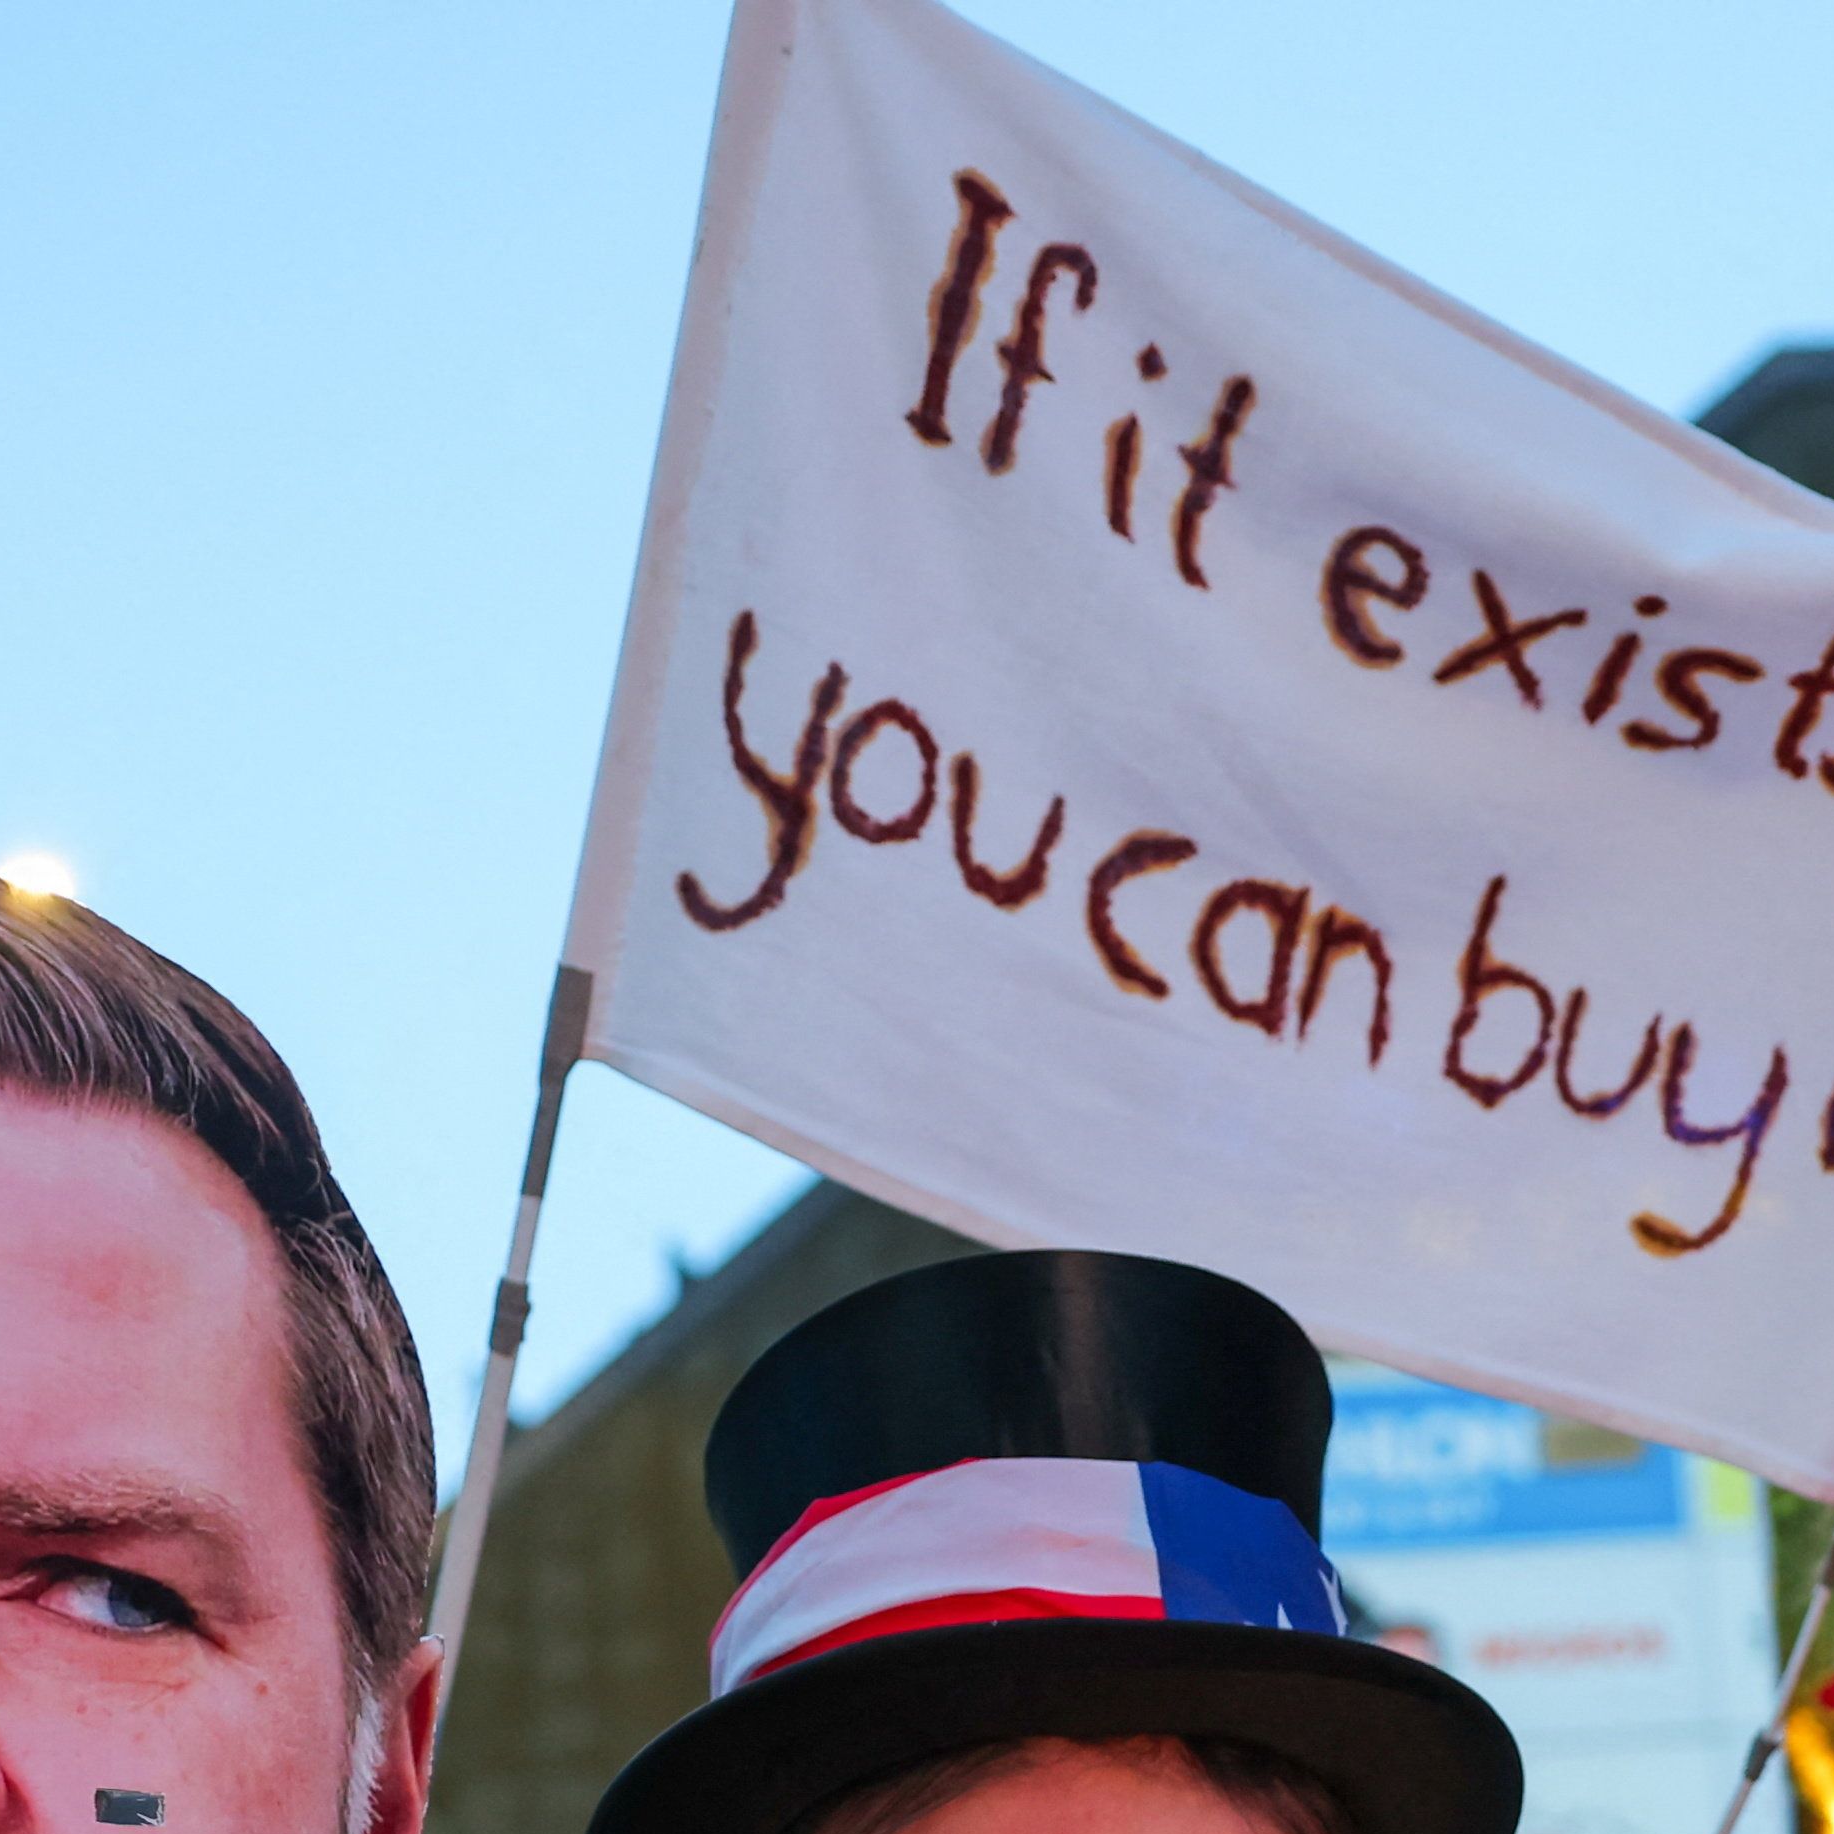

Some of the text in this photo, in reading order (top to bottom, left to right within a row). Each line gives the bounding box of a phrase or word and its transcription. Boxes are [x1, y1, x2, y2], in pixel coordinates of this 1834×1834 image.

[904, 167, 1098, 476] If
[1104, 341, 1257, 590] it
[676, 610, 1065, 934] you
[1085, 828, 1395, 1068] can
[1442, 874, 1789, 1258] buy
